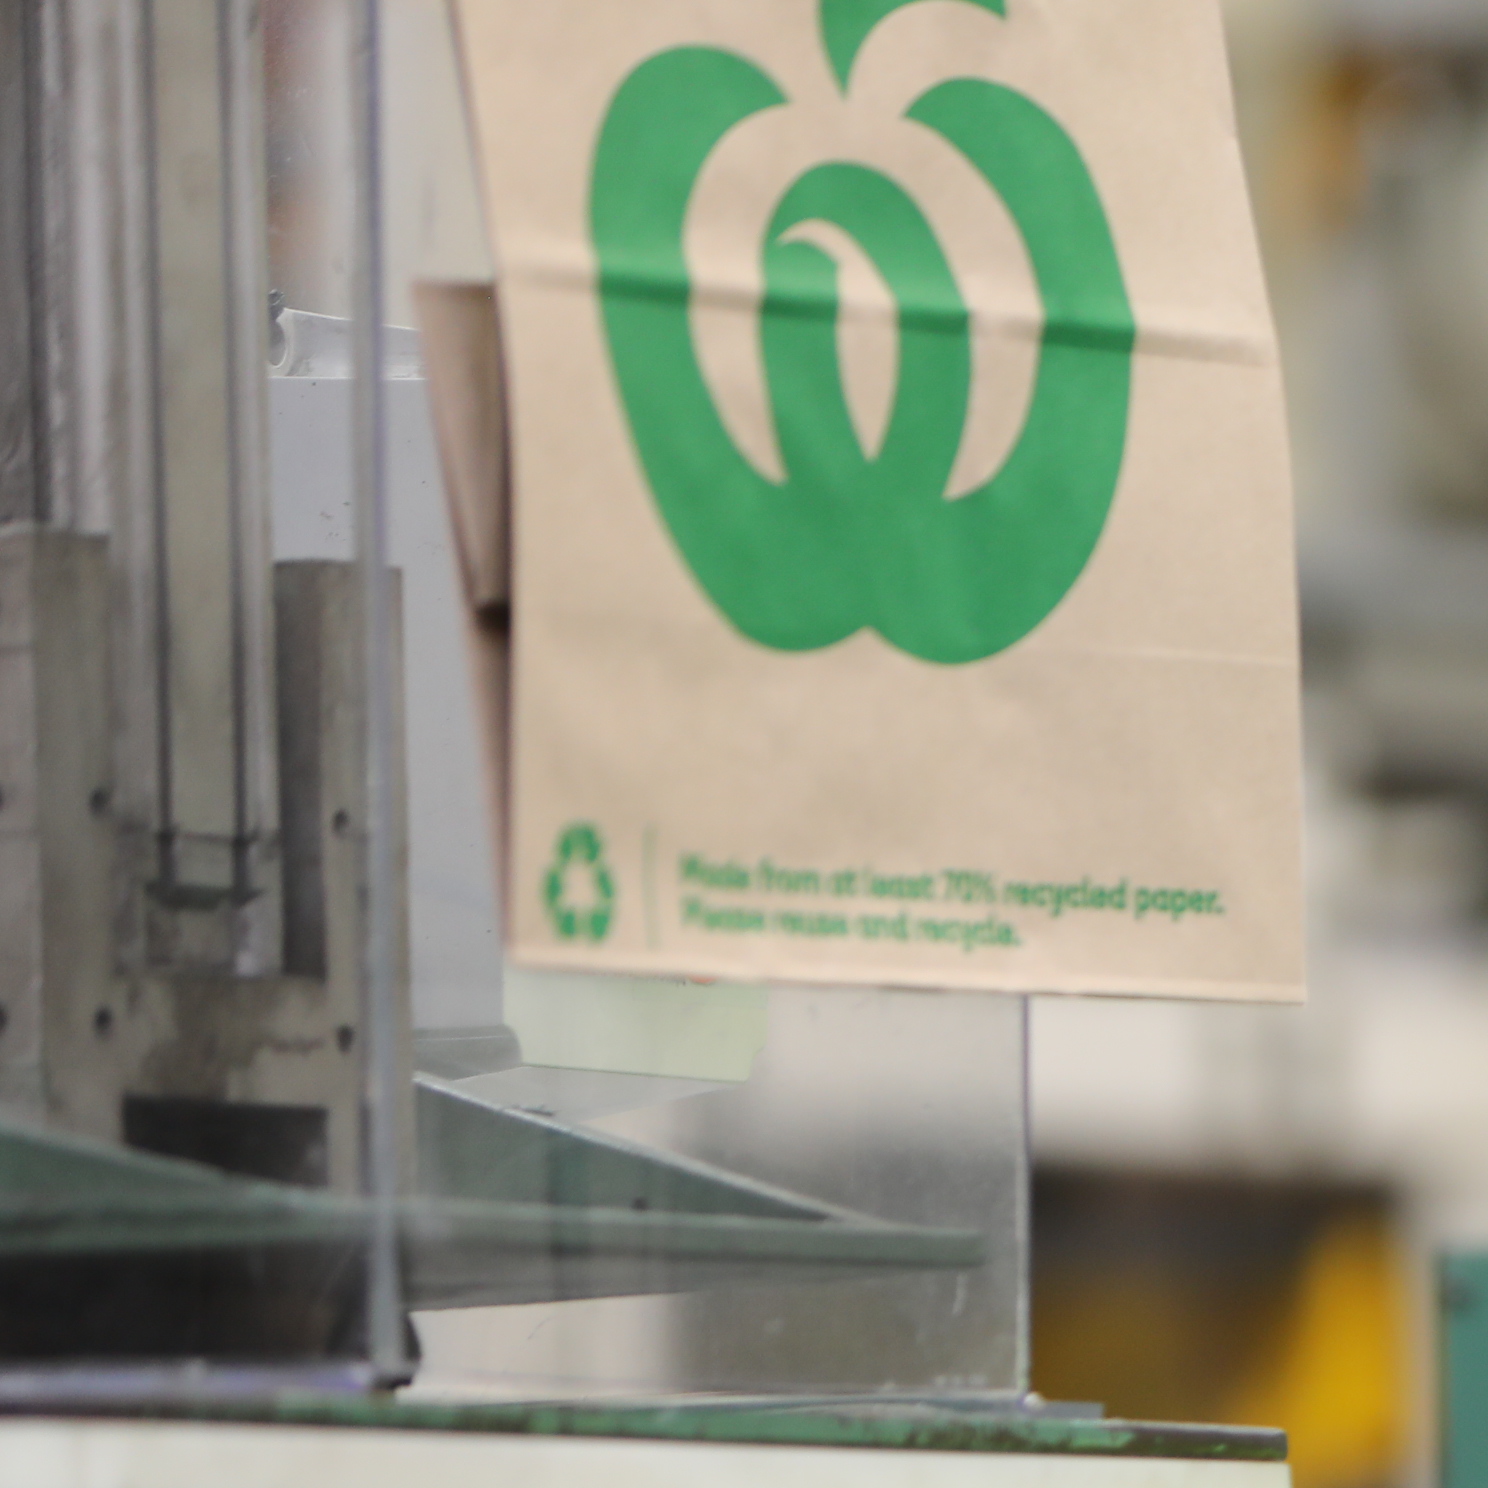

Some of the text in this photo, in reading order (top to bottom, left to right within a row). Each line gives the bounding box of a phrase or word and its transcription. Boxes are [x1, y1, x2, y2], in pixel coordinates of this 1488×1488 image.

[680, 852, 1225, 921] Made from at least 70% recycled paper.
[680, 897, 1021, 954] Please reuse and recycle.
